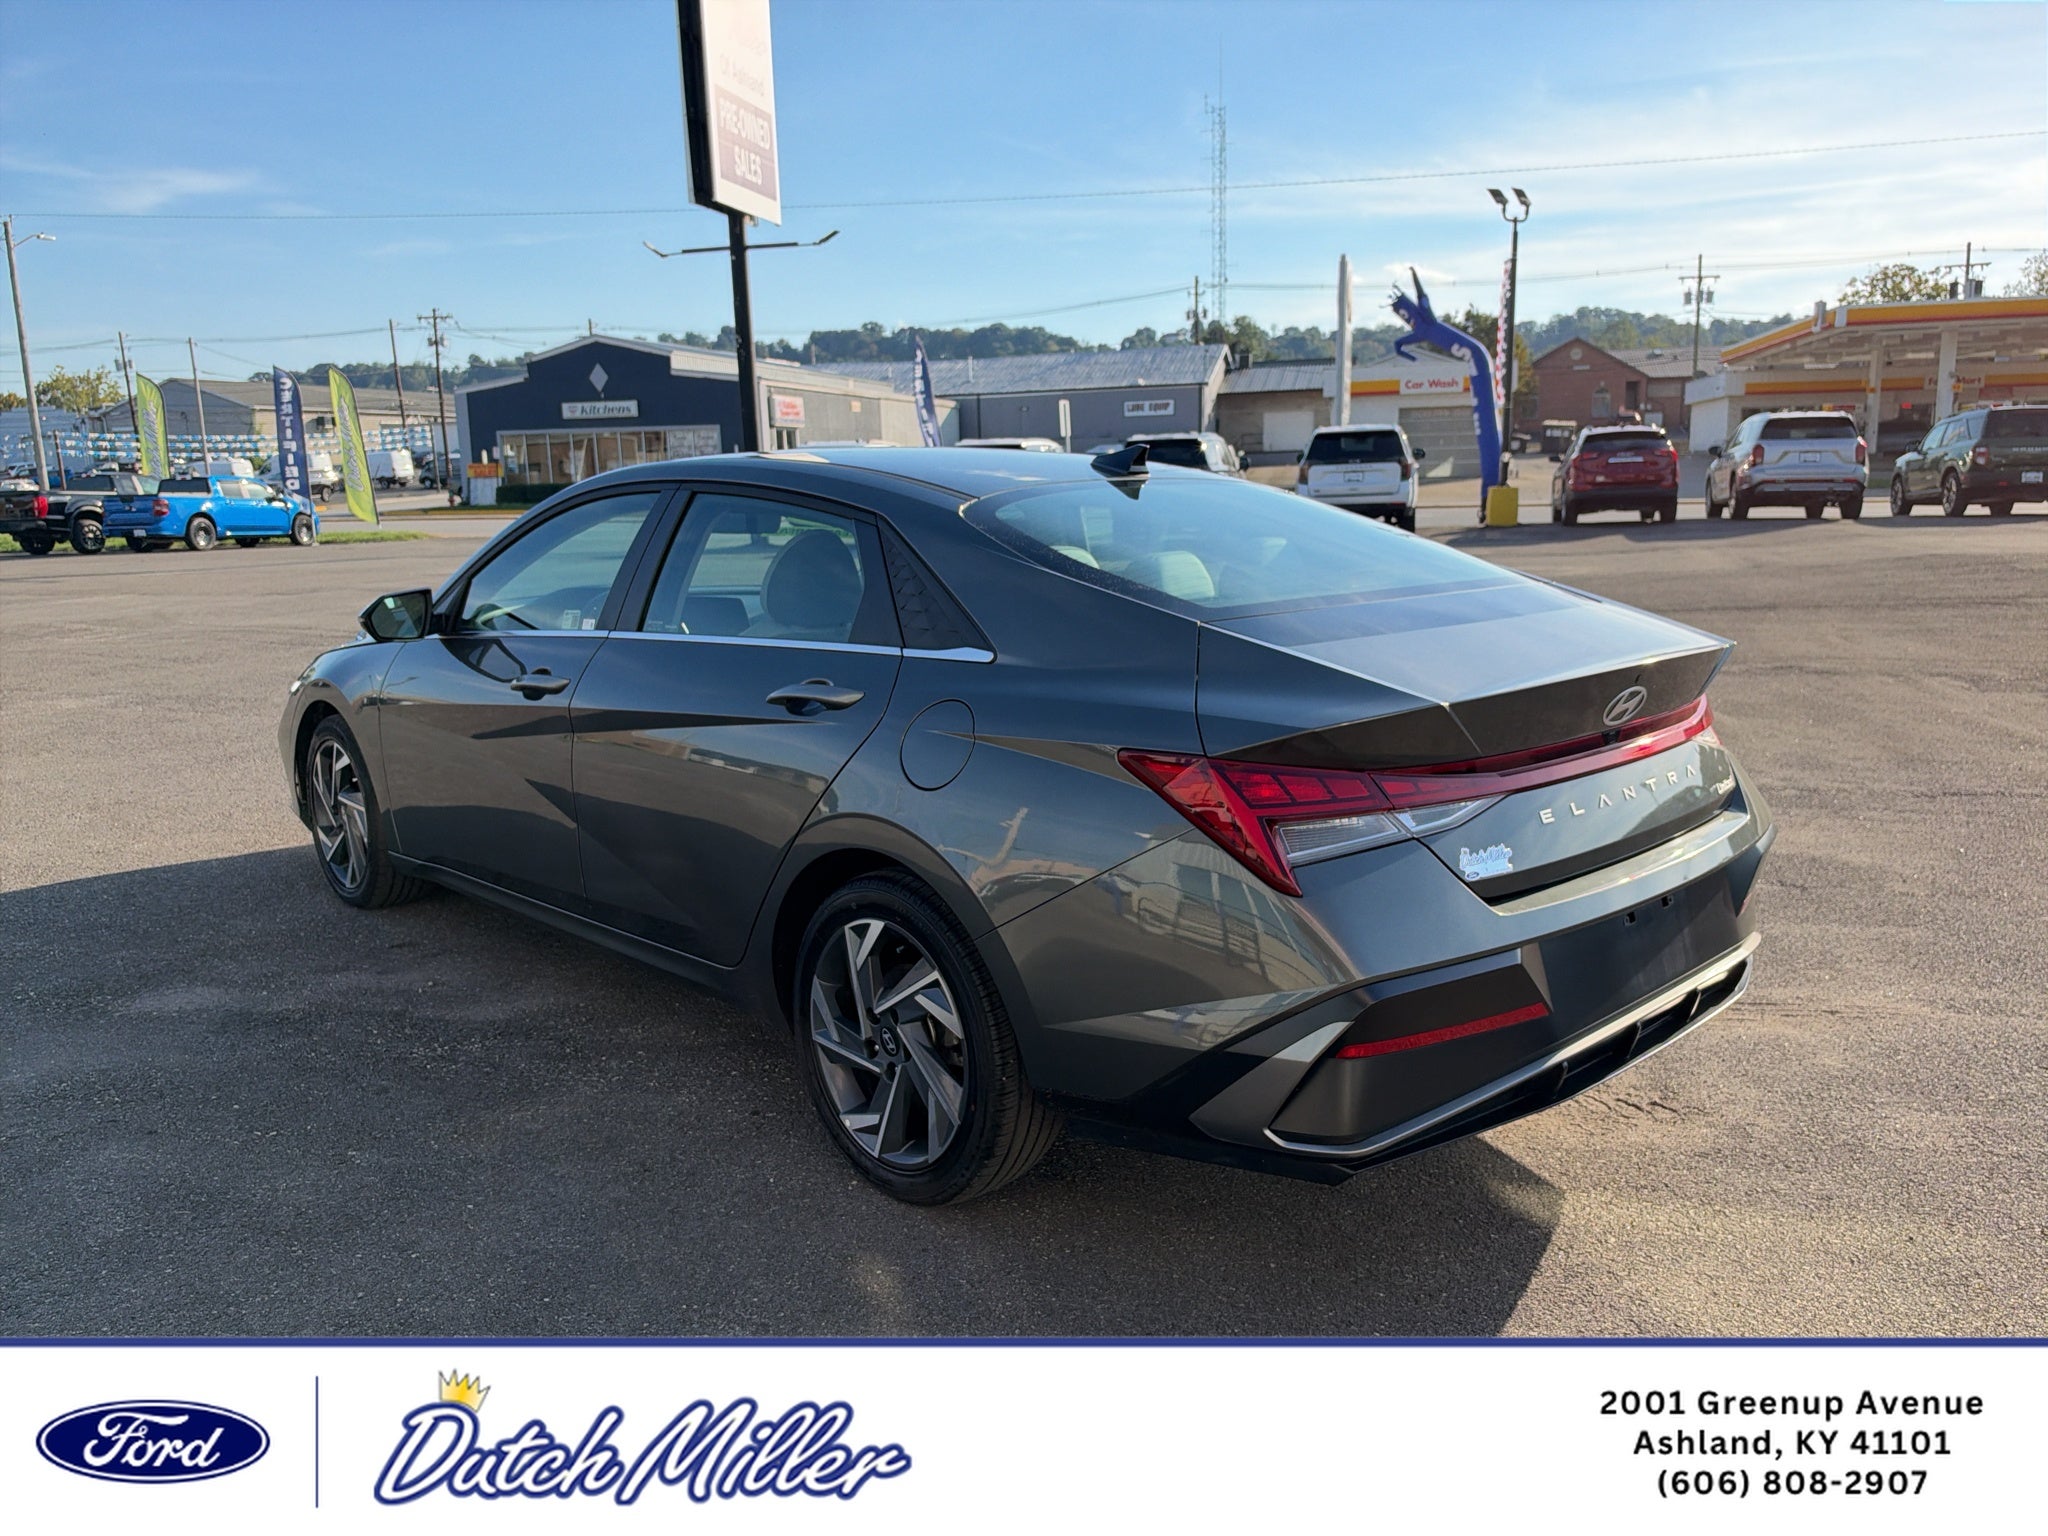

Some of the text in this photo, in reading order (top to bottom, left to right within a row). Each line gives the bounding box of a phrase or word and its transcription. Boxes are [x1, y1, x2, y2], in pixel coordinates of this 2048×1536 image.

[720, 97, 771, 150] PRE-OWNED
[734, 144, 762, 185] SALES
[1405, 377, 1459, 390] Car Wash
[1539, 764, 1696, 825] ELANTRA
